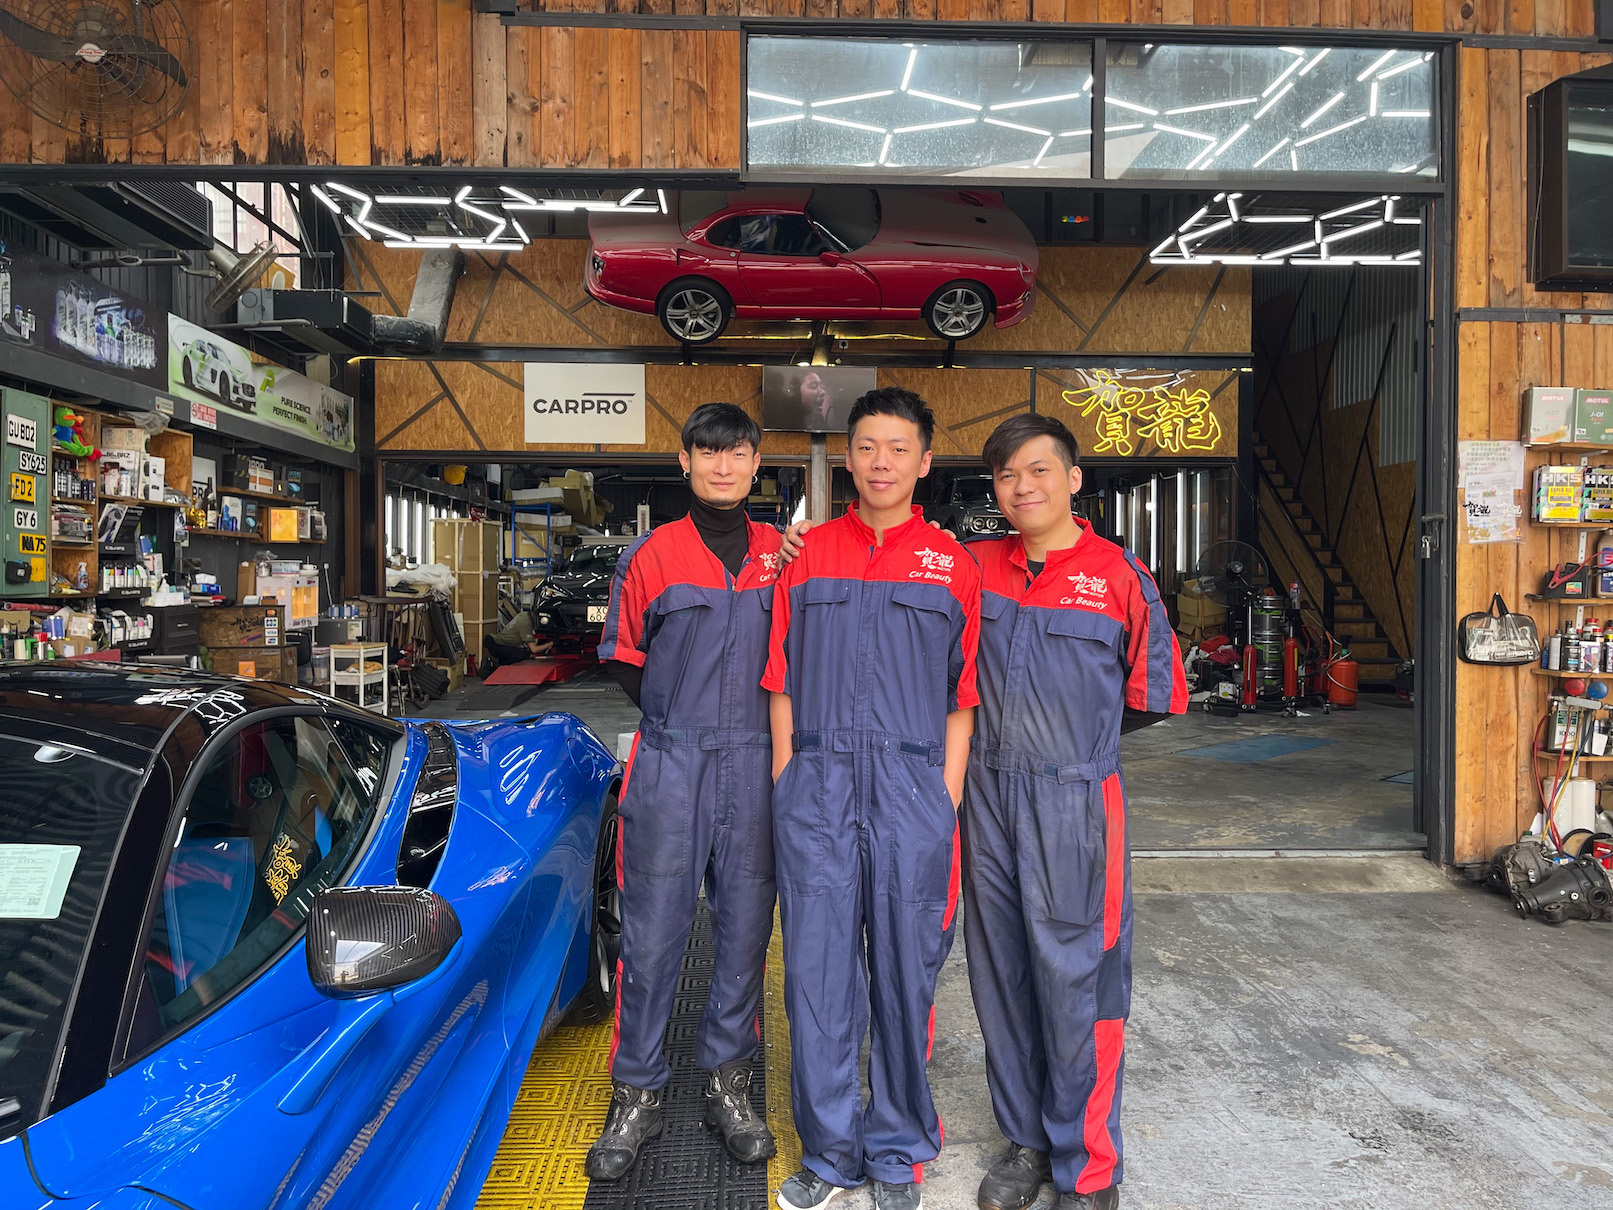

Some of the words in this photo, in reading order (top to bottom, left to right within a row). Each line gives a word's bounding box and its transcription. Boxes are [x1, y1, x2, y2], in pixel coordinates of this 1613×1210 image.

[281, 396, 293, 408] PURE
[533, 398, 628, 415] CARPRO
[272, 406, 293, 420] PERFECT
[1542, 473, 1582, 483] HKS
[27, 481, 33, 496] 2
[16, 510, 28, 526] GY
[30, 512, 36, 528] 6
[34, 536, 46, 552] 75
[759, 574, 771, 582] Car
[924, 571, 952, 584] Beauty
[1060, 596, 1075, 605] Car
[1075, 596, 1108, 610] Beauty
